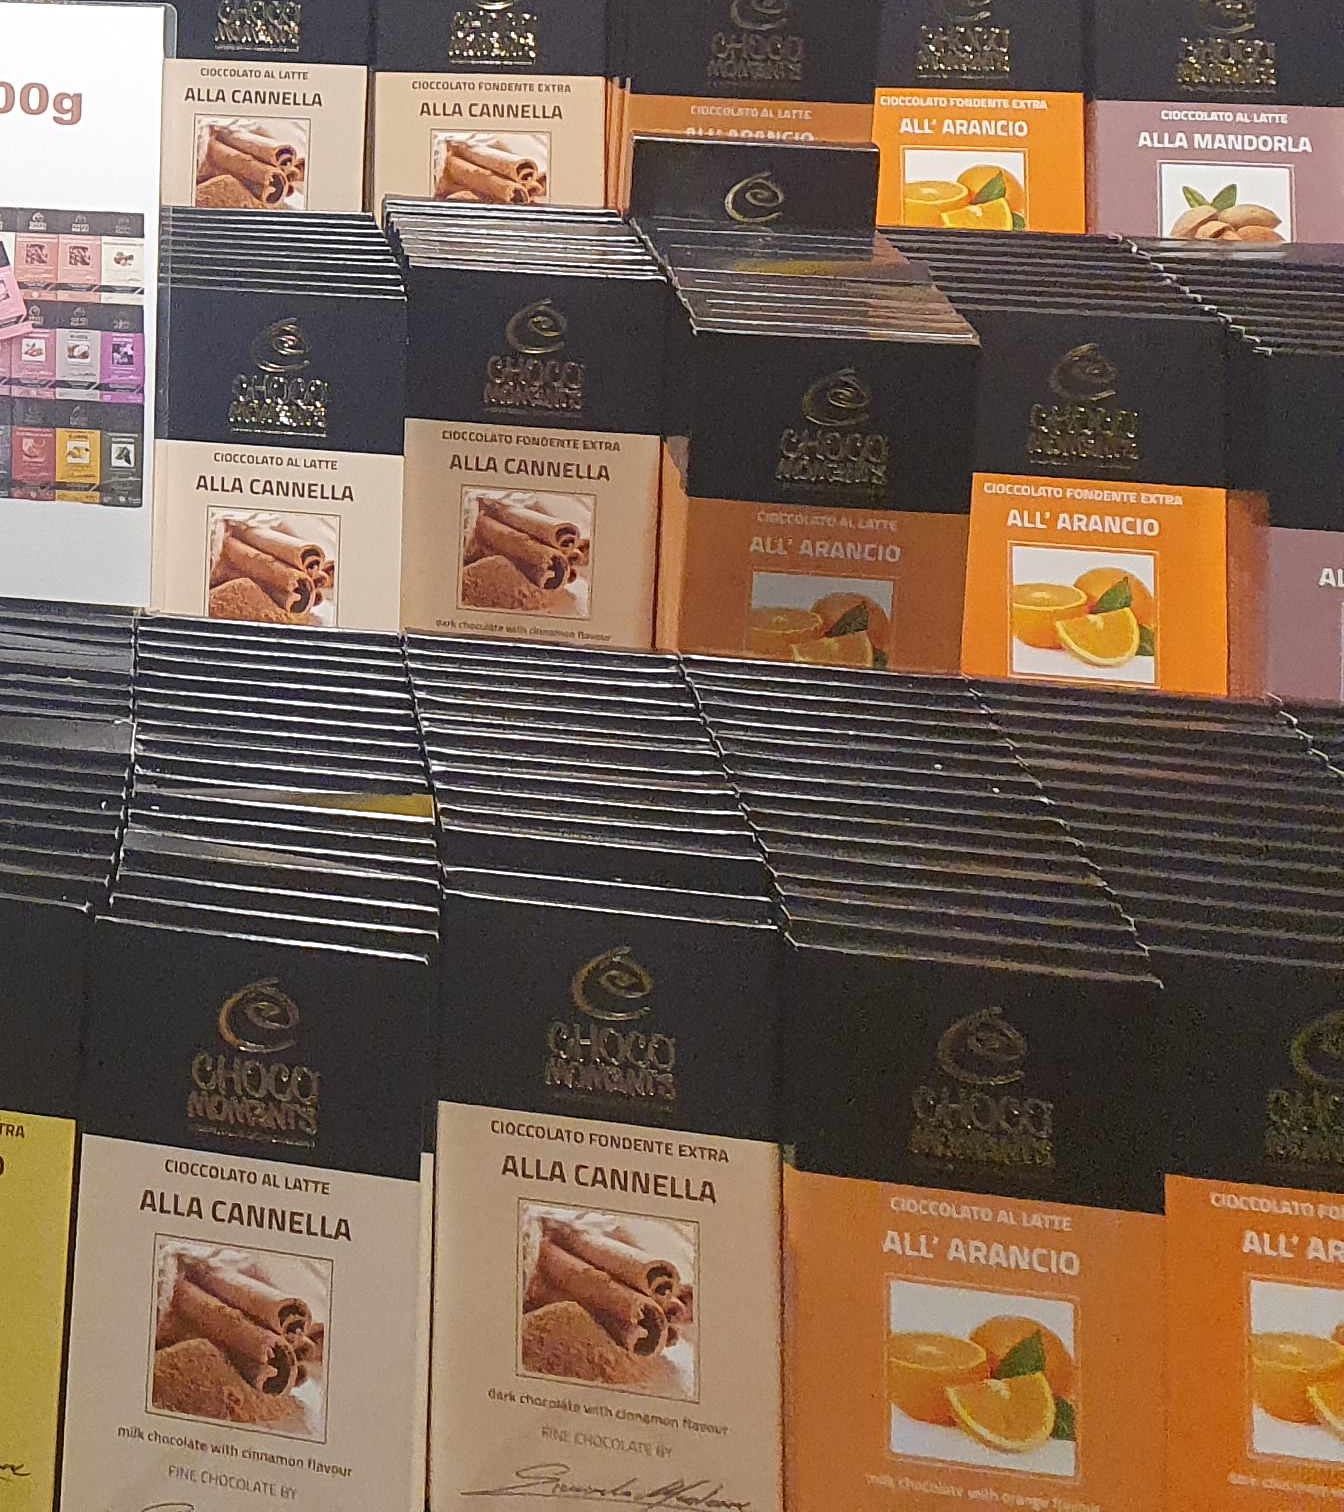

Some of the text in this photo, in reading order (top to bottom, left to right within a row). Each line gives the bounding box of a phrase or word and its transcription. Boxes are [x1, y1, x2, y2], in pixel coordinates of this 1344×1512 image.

[184, 87, 322, 107] ALLA CANNELLA
[420, 102, 562, 120] ALLA CANNELLA
[1161, 110, 1288, 124] CIOCCOLATO AL LATTE
[942, 118, 1028, 137] ARANCIO
[1138, 132, 1312, 152] ALLA MANDORLA
[213, 451, 338, 470] CIOCCOLATO AL LATTE
[449, 453, 610, 482] ALLA CANNELLA
[196, 475, 354, 502] ALLA CANNELLA
[983, 483, 1182, 506] CIOCCOLATO FONDENTE EXTRA
[1057, 514, 1159, 537] ARANCIO
[491, 1119, 729, 1163] CIOCCOLATO FONDENTE EXTRA
[165, 1159, 330, 1195] CIOCCOLATO AL LATTE
[501, 1155, 717, 1204] ALLA CANNELLA
[140, 1189, 351, 1241] ALLA CANNELLA
[891, 1197, 1072, 1232] CIOCCOLATO AL LATTE
[948, 1239, 1080, 1275] ARANCIO
[118, 1425, 352, 1477] milk chocolate with cinnamon flavour
